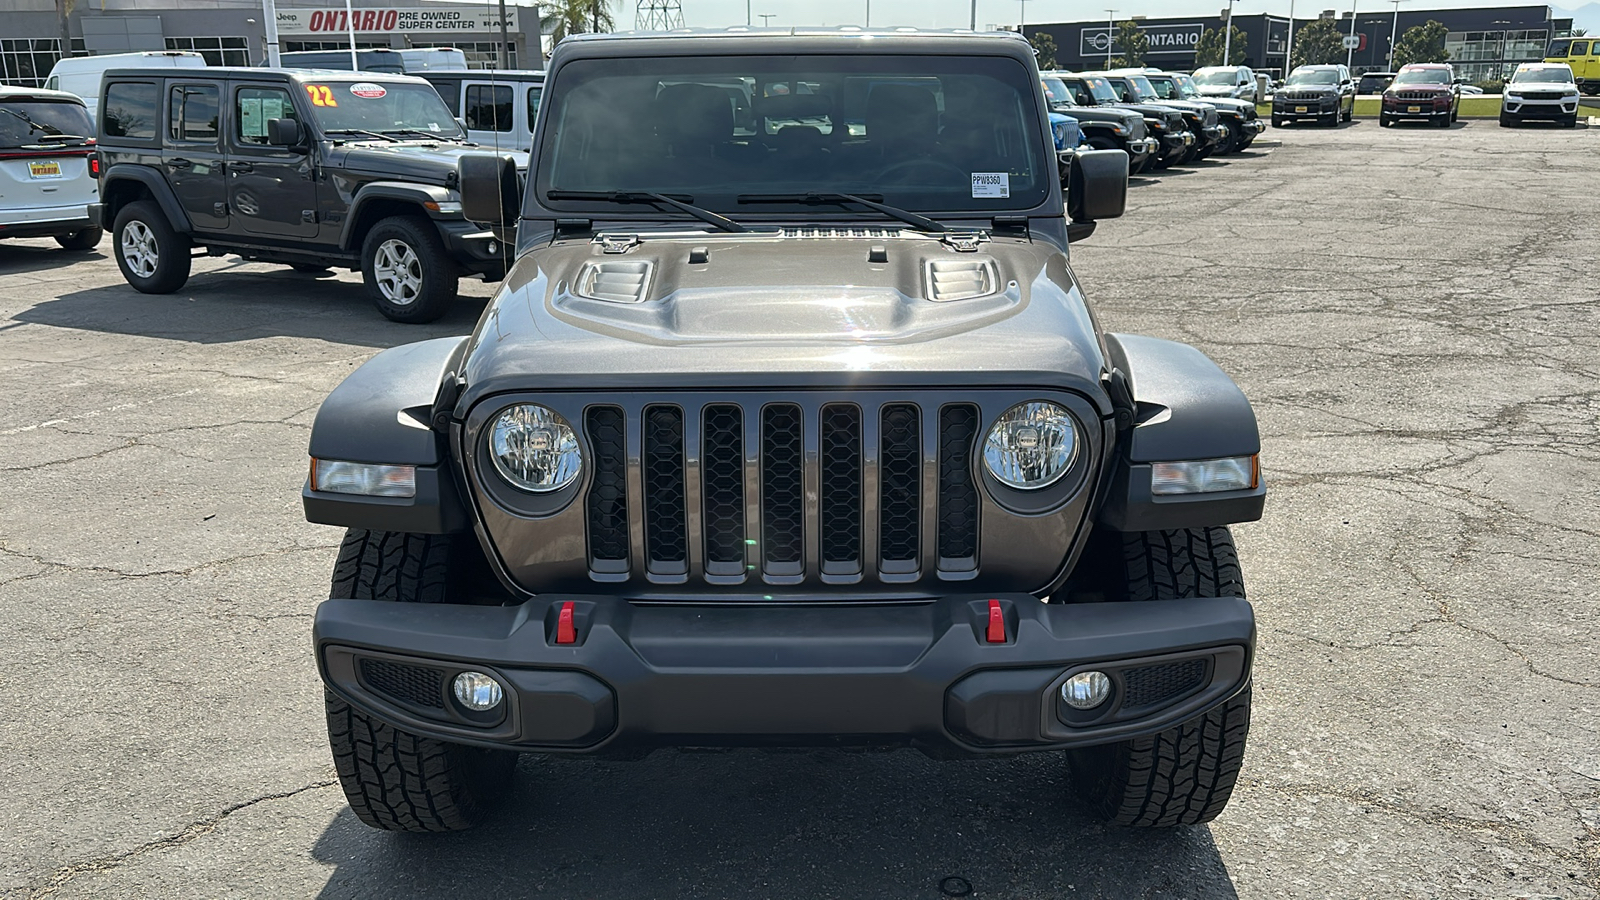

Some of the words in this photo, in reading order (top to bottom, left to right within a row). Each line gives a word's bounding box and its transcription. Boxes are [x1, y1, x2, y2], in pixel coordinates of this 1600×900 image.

[276, 13, 297, 21] Jeep
[398, 12, 418, 20] PRE
[421, 12, 460, 20] OWNED
[309, 10, 397, 32] ONTARIO
[399, 21, 432, 29] SUPER
[435, 21, 475, 29] CENTER
[306, 85, 338, 107] 22
[32, 167, 57, 175] ONTARIO
